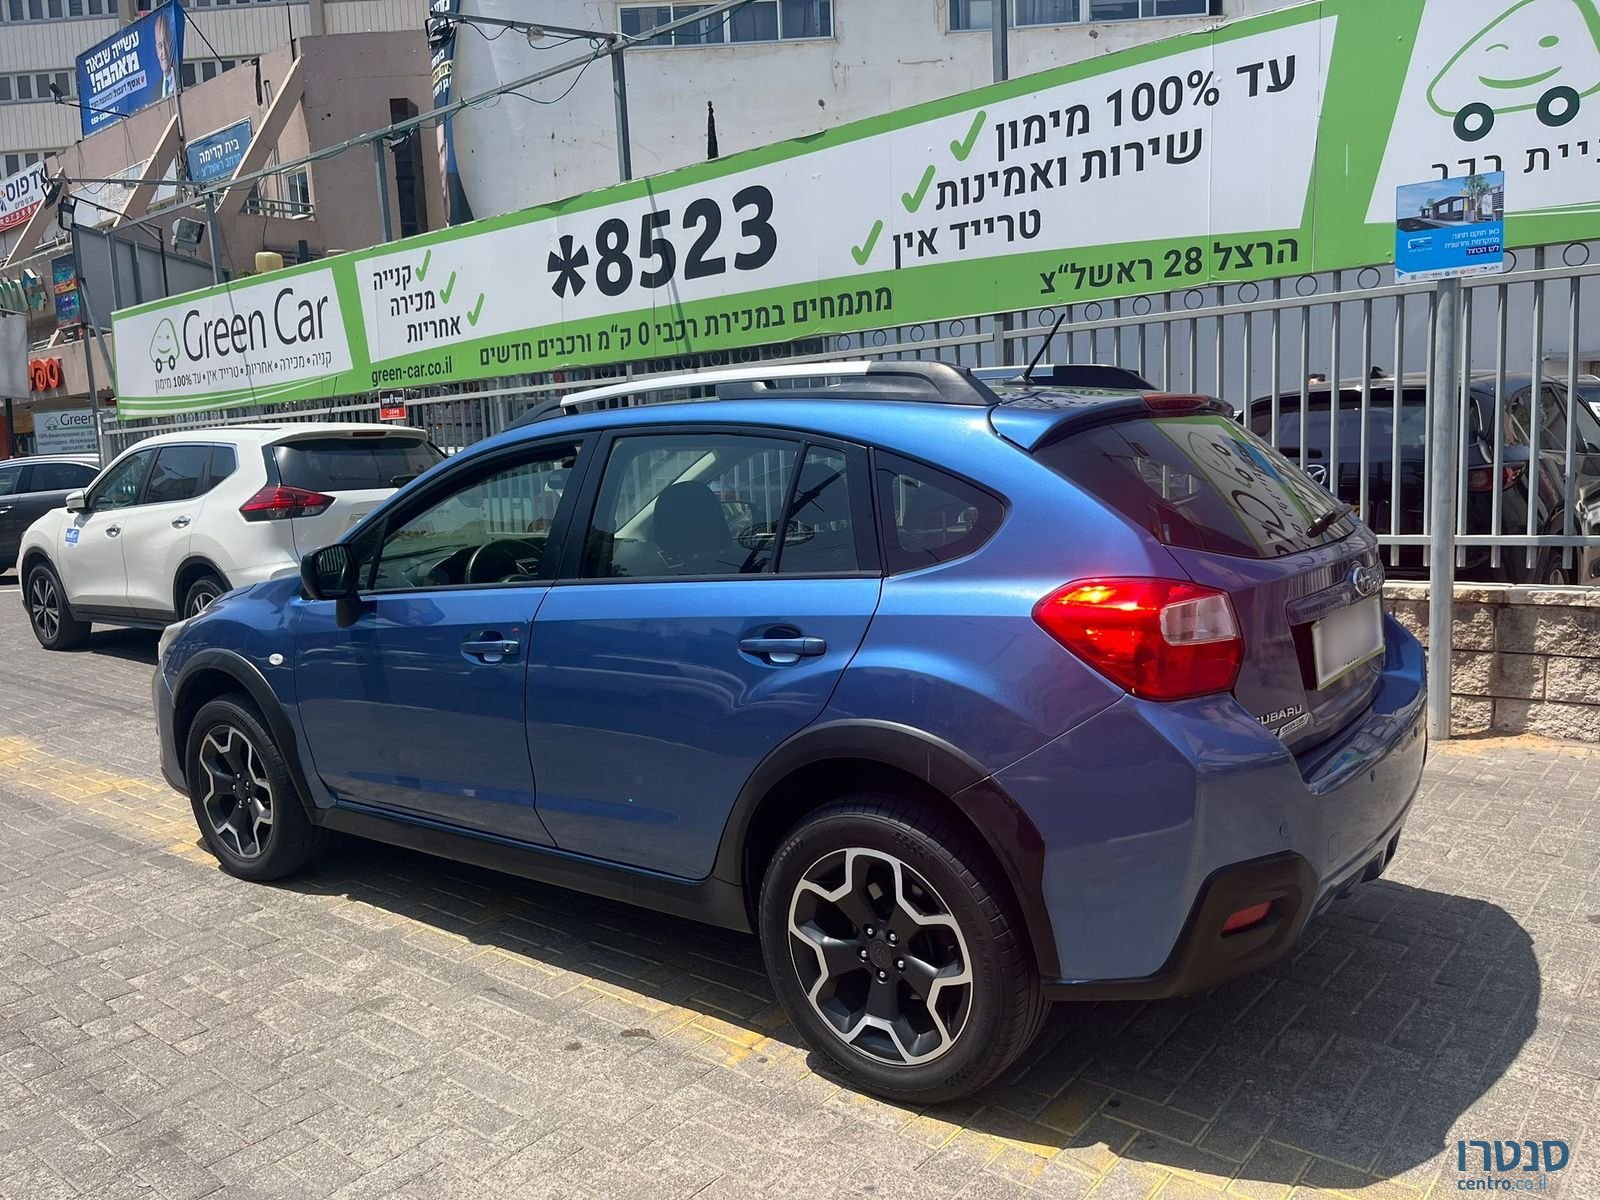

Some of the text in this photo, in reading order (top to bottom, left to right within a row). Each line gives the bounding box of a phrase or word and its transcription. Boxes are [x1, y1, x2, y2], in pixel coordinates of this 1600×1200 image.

[85, 31, 140, 74] עשייה שבאה
[90, 51, 140, 93] מאהבה!
[995, 54, 1296, 162] עד 100% מימון
[199, 139, 240, 164] בית קדימה
[935, 128, 1202, 211] שירות ואמינות
[892, 208, 1042, 270] טרייד אין
[1214, 238, 1298, 272] הרצל
[373, 265, 411, 291] קנייה
[1164, 246, 1203, 279] 28
[390, 290, 435, 316] מכירה
[793, 286, 893, 324] מתמחים
[183, 287, 328, 362] Green Car
[407, 315, 461, 343] אחריות
[638, 322, 650, 346] 0
[655, 317, 698, 344] רכבי
[704, 303, 785, 339] במכירת
[479, 342, 532, 366] חדשים
[537, 332, 592, 356] ורכבים
[154, 351, 332, 394] קניה מכירה אחריות טרייד אין עד 100% מימון
[371, 355, 453, 387] green-car.co.il
